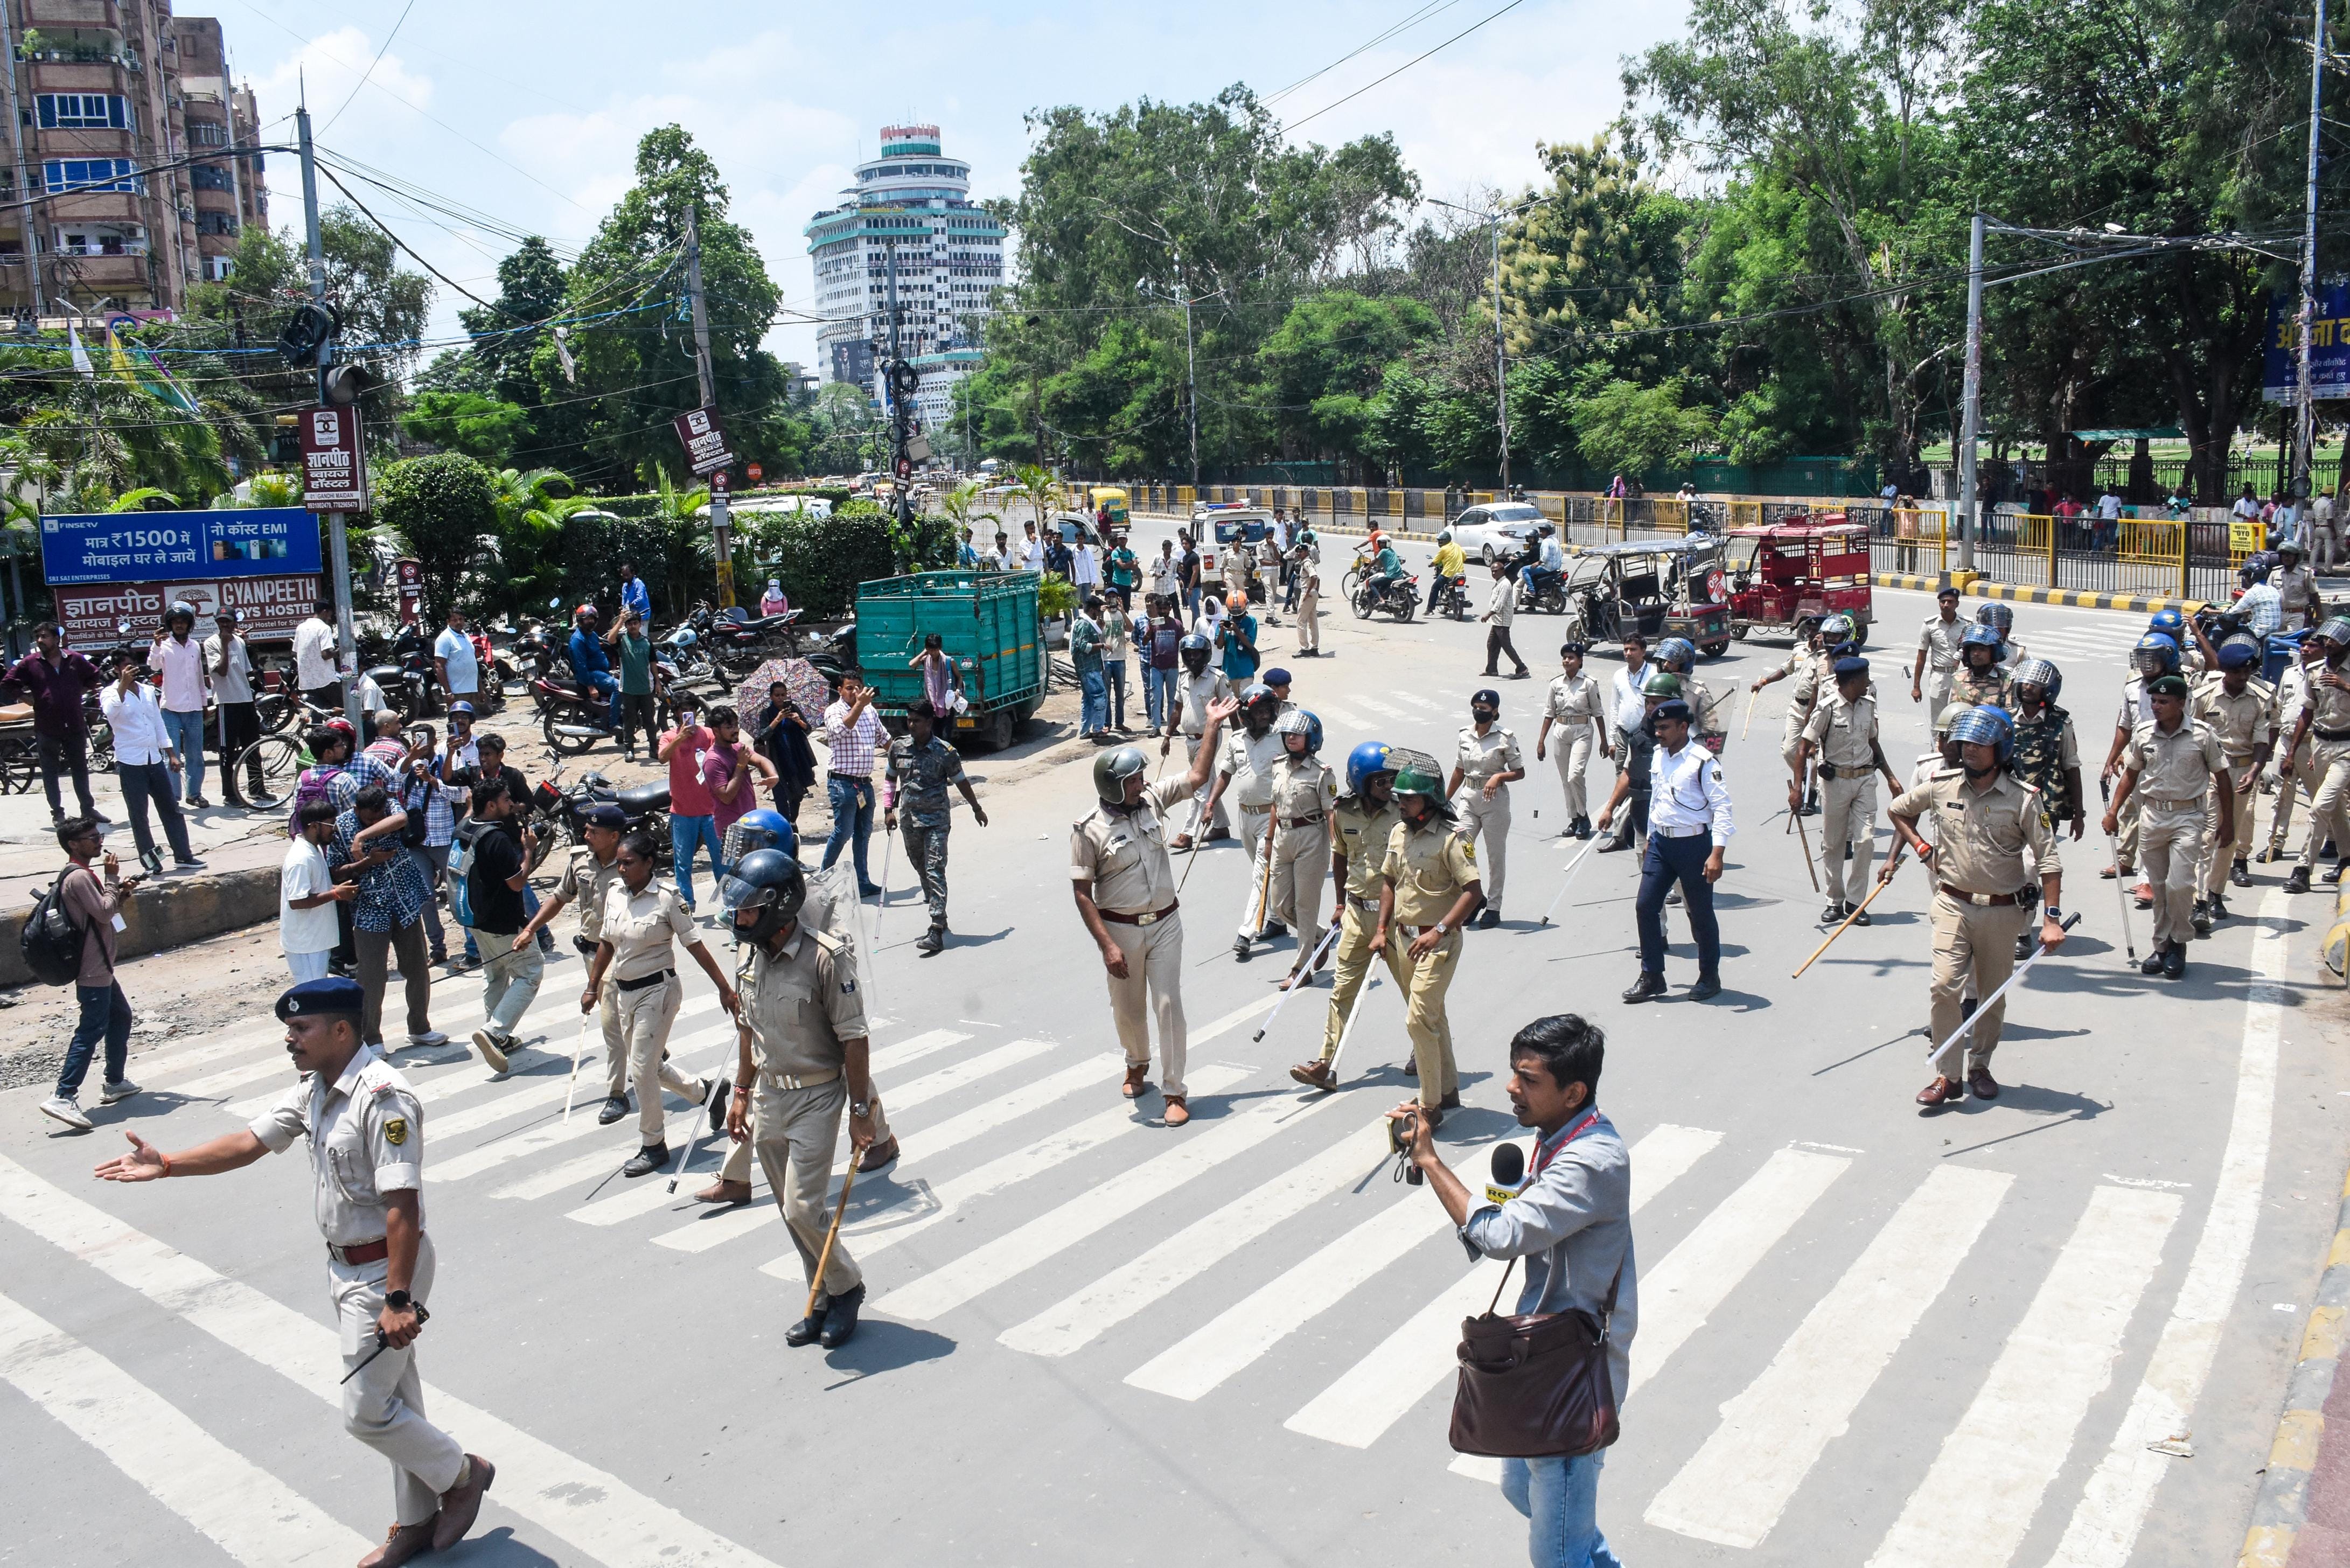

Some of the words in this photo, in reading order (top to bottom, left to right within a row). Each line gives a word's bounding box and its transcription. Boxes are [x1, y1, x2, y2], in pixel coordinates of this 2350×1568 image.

[688, 431, 722, 450] ज्ञानपीठ
[306, 447, 350, 468] ज्ञानपीठ
[309, 470, 349, 478] ब्वायज
[310, 478, 351, 489] हॉस्टल
[210, 521, 224, 536] नो
[227, 521, 259, 535] कॉस्ट
[262, 524, 288, 534] EMI
[85, 537, 108, 548] मात्र
[111, 529, 177, 547] ₹1500
[180, 531, 191, 545] में
[82, 552, 130, 567] मोबाइल
[134, 553, 151, 564] घर
[154, 549, 167, 563] ले
[170, 548, 197, 562] जायें
[222, 577, 317, 605] GYANPEETH
[62, 588, 161, 618] ज्ञानपीठ
[235, 606, 261, 618] OYS
[65, 618, 111, 629] ब्वायज
